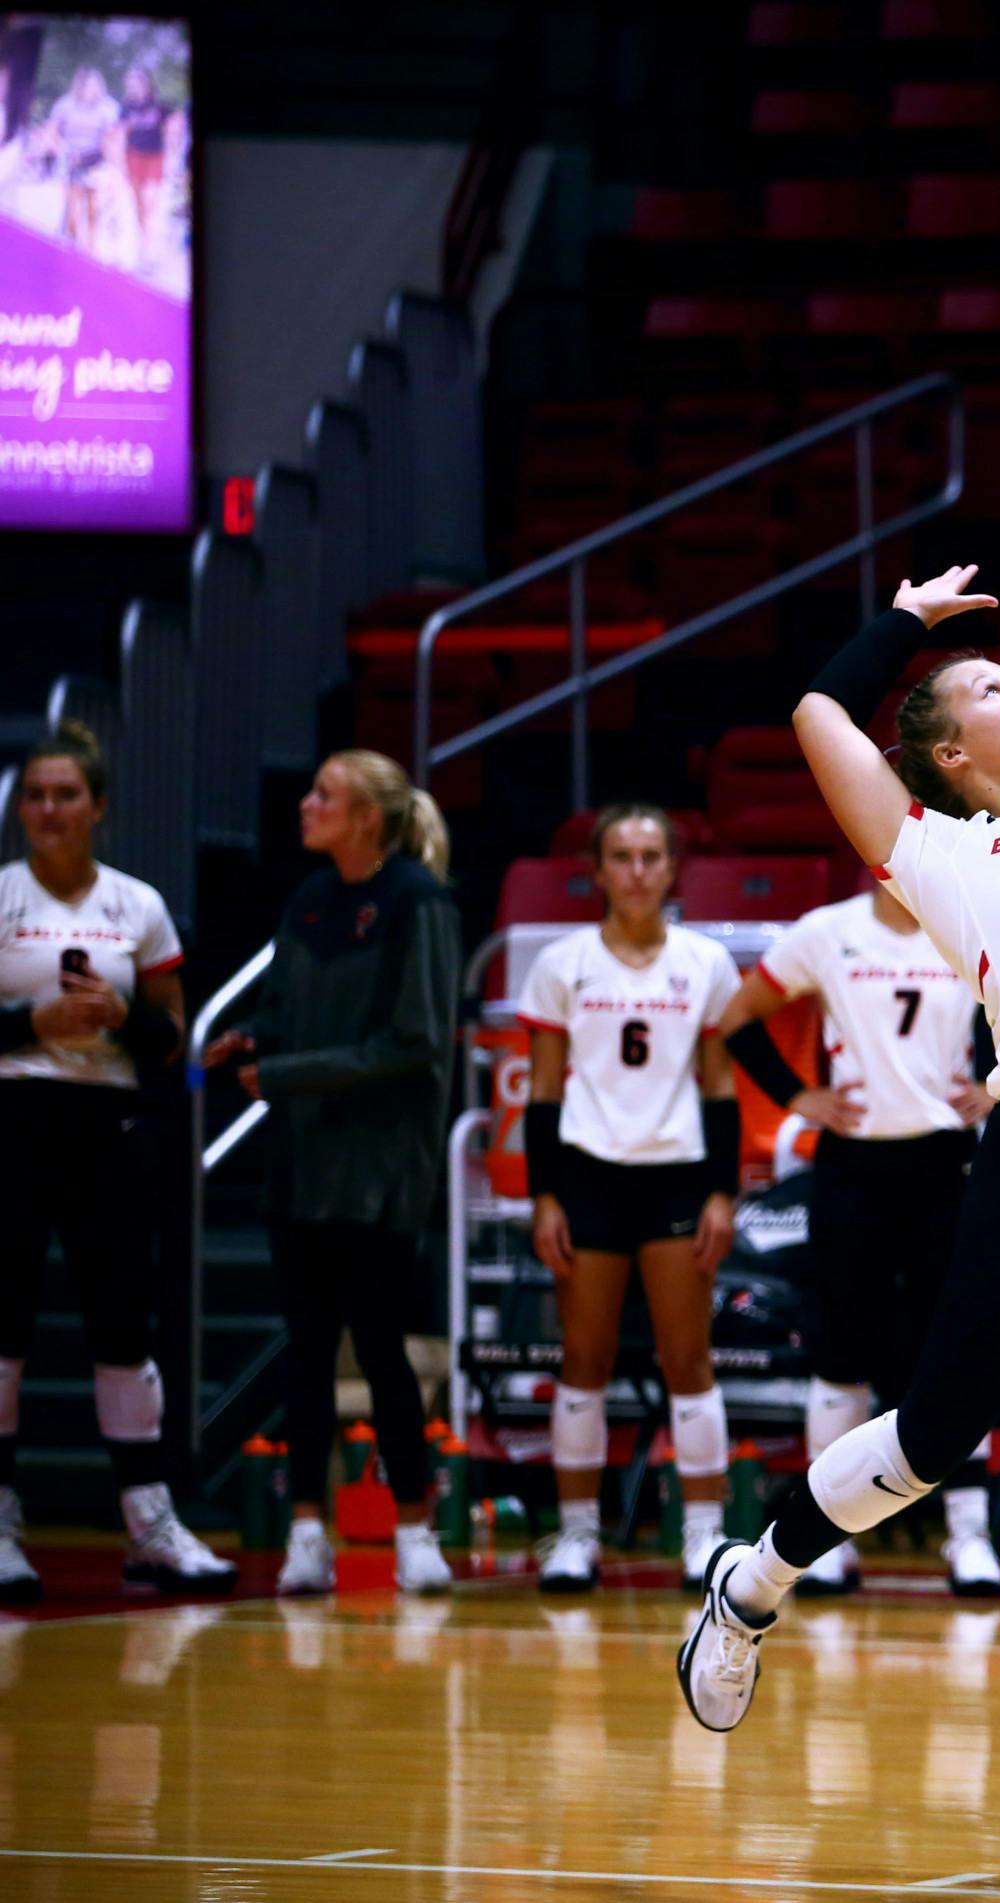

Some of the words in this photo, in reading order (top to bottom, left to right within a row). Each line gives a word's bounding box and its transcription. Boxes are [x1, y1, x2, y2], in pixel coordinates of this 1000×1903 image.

[74, 348, 173, 399] place
[894, 988, 922, 1037] 7
[621, 1017, 650, 1069] 6
